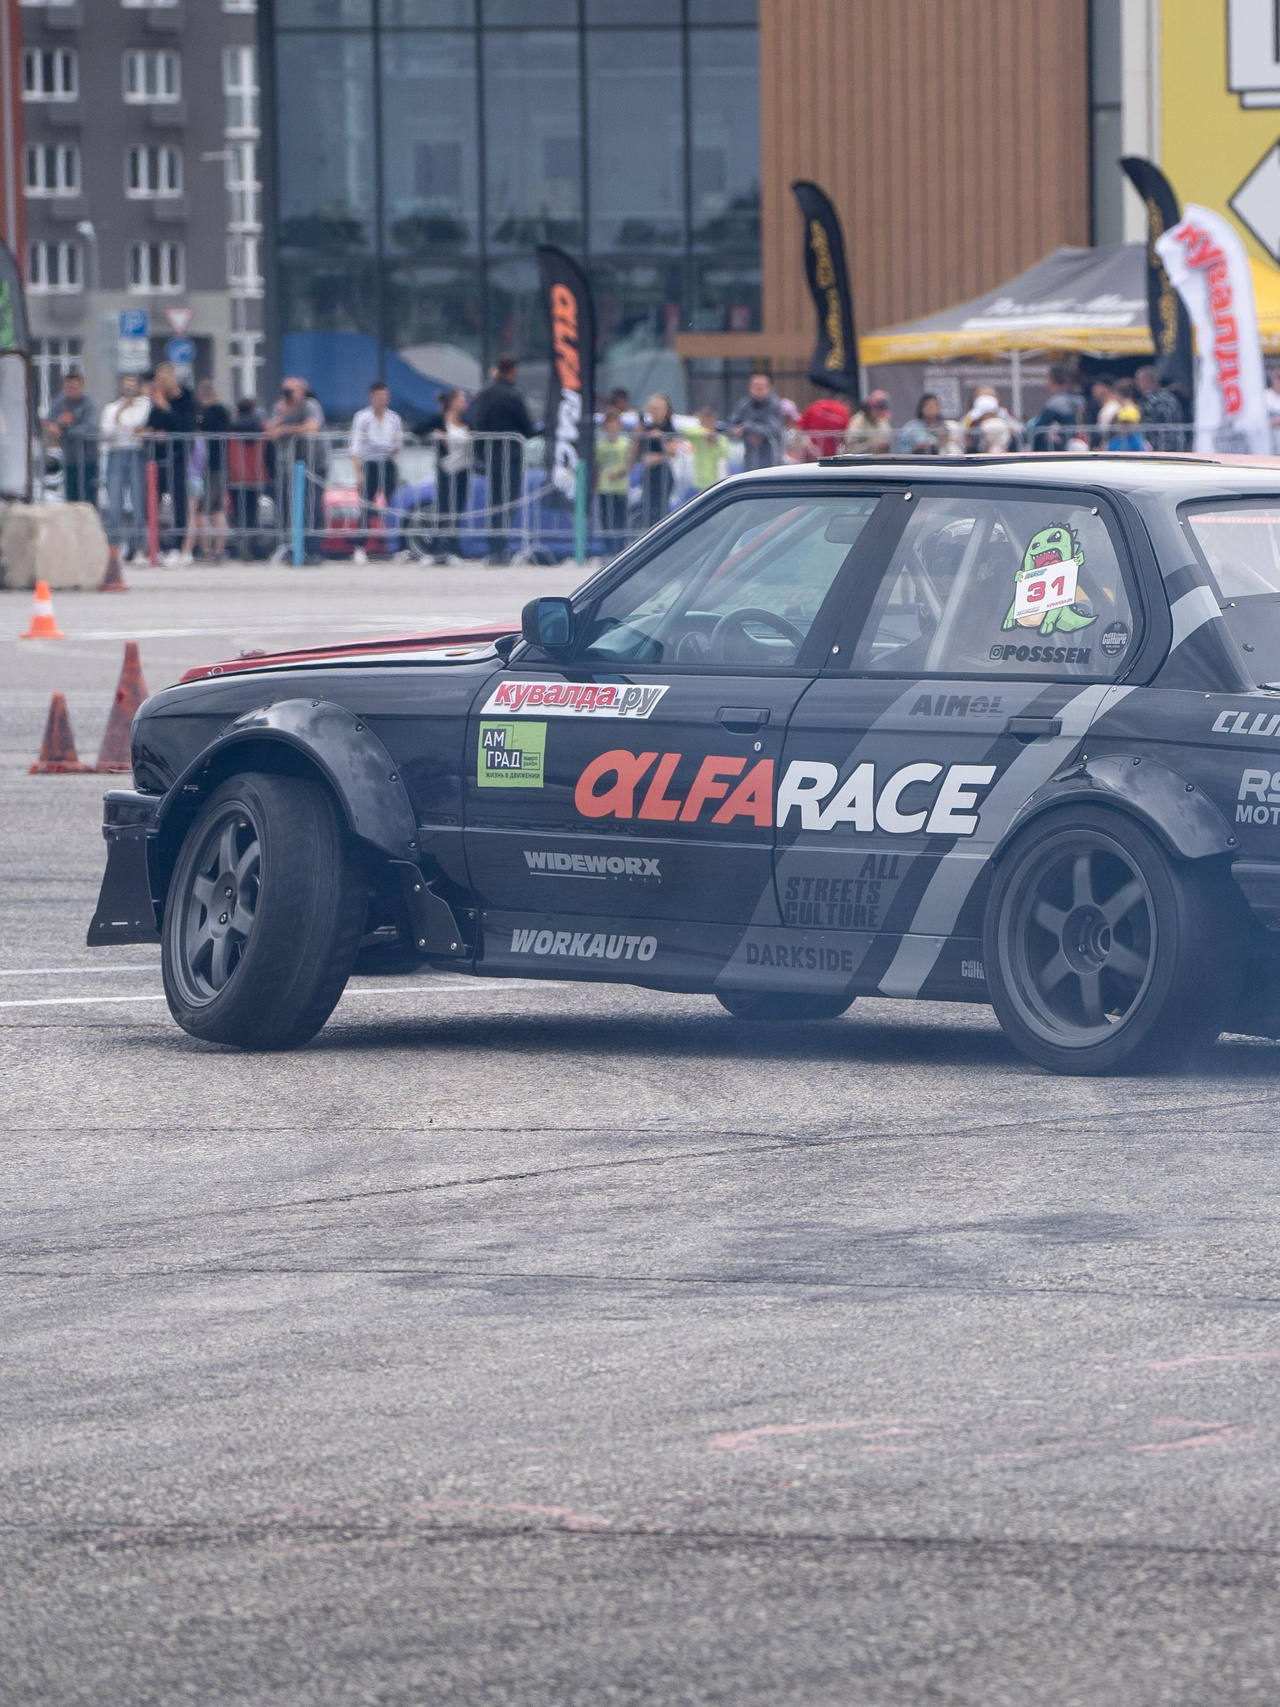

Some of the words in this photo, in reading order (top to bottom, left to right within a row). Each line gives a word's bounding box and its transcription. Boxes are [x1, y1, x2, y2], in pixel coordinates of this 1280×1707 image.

[1027, 575, 1065, 602] 31
[494, 683, 662, 715] кувалда.ру
[908, 694, 1004, 718] AIMOL
[483, 731, 505, 747] АМ
[487, 750, 520, 767] ГРАД
[523, 851, 661, 877] WIDEWORX
[859, 853, 900, 880] ALL
[785, 876, 882, 905] STREETS
[783, 901, 879, 928] CULTURE
[510, 929, 658, 961] WORKAUTO
[746, 942, 852, 972] DARKSIDE
